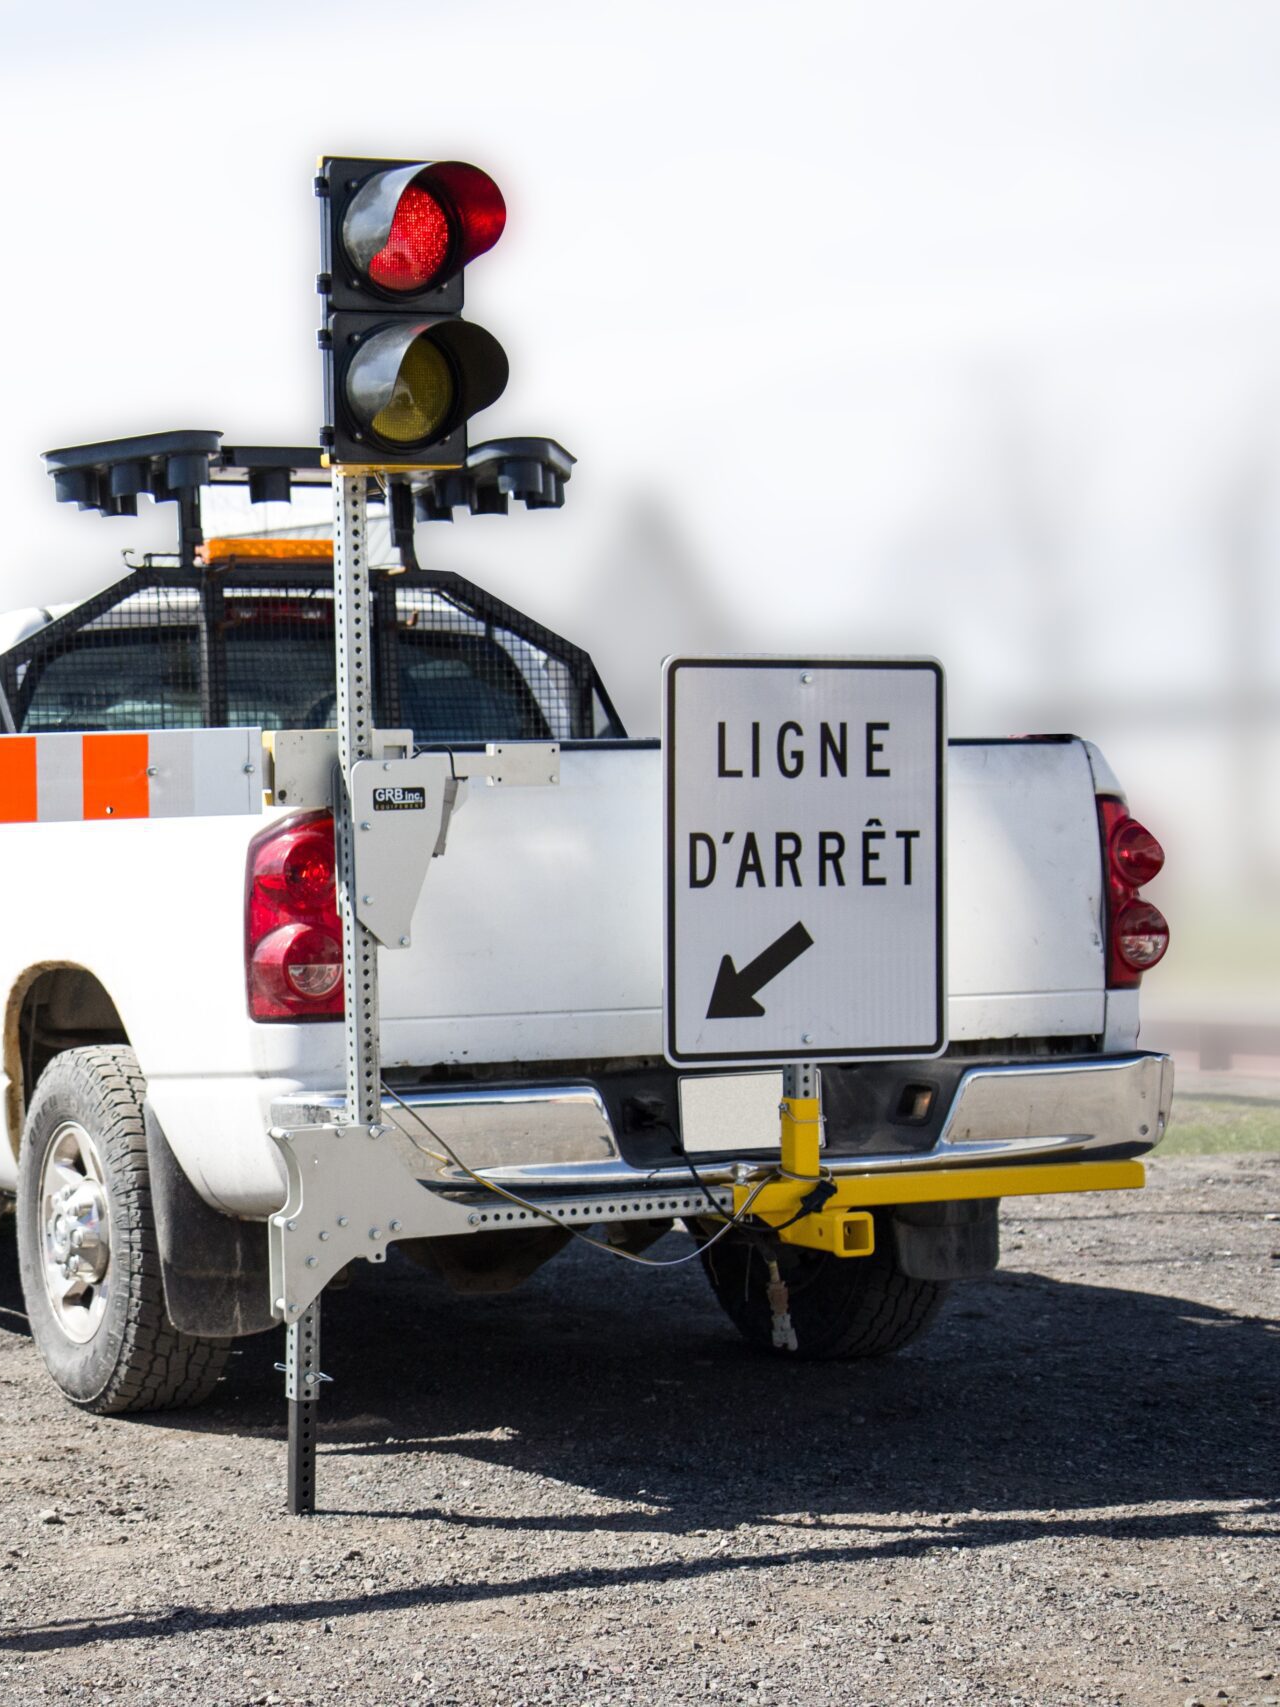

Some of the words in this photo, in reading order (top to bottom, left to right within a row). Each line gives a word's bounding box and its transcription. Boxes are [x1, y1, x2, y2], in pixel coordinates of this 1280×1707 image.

[718, 721, 890, 778] LIGNE
[375, 788, 403, 802] GRB
[689, 818, 920, 888] D'ARRÊT
